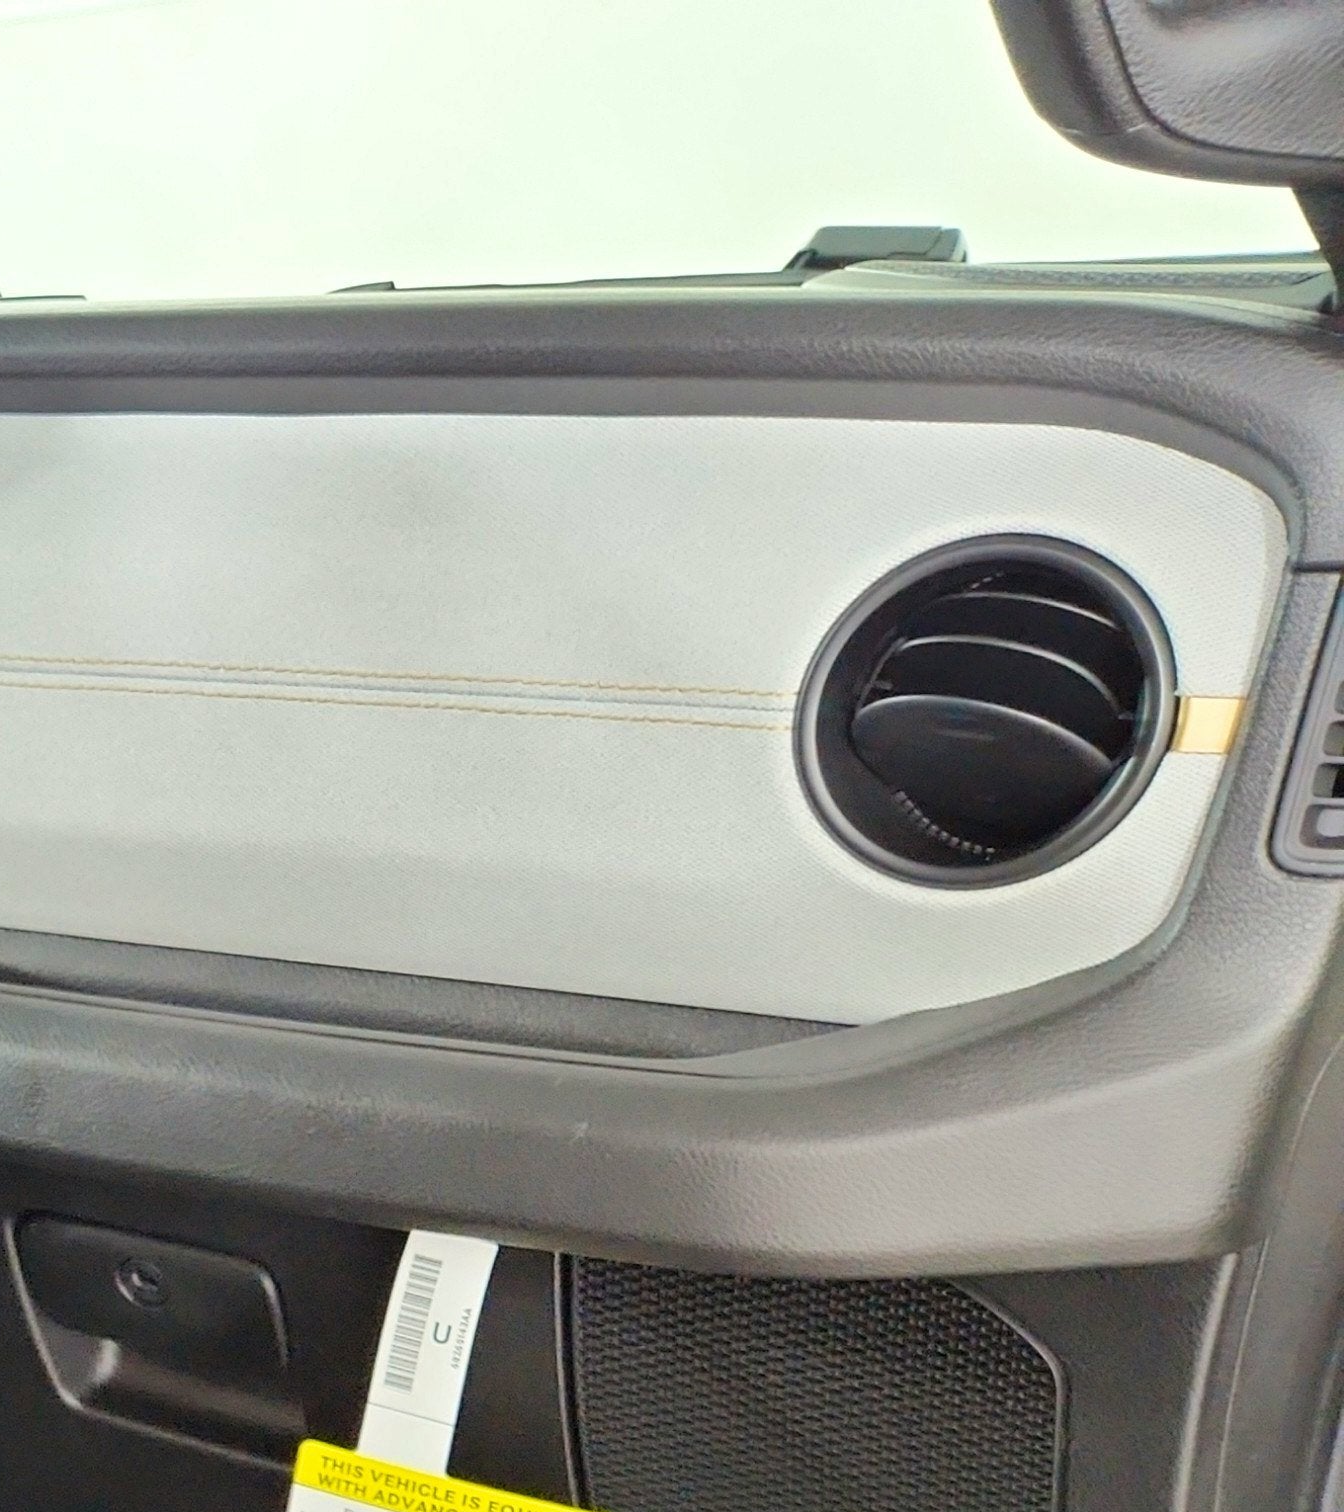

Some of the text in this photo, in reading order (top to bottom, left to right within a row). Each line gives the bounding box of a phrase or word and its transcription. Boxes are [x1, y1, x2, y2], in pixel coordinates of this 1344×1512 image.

[316, 1472, 368, 1498] WITH
[320, 1455, 365, 1479] THIS
[370, 1469, 456, 1504] VEHICLE
[460, 1492, 482, 1510] IS
